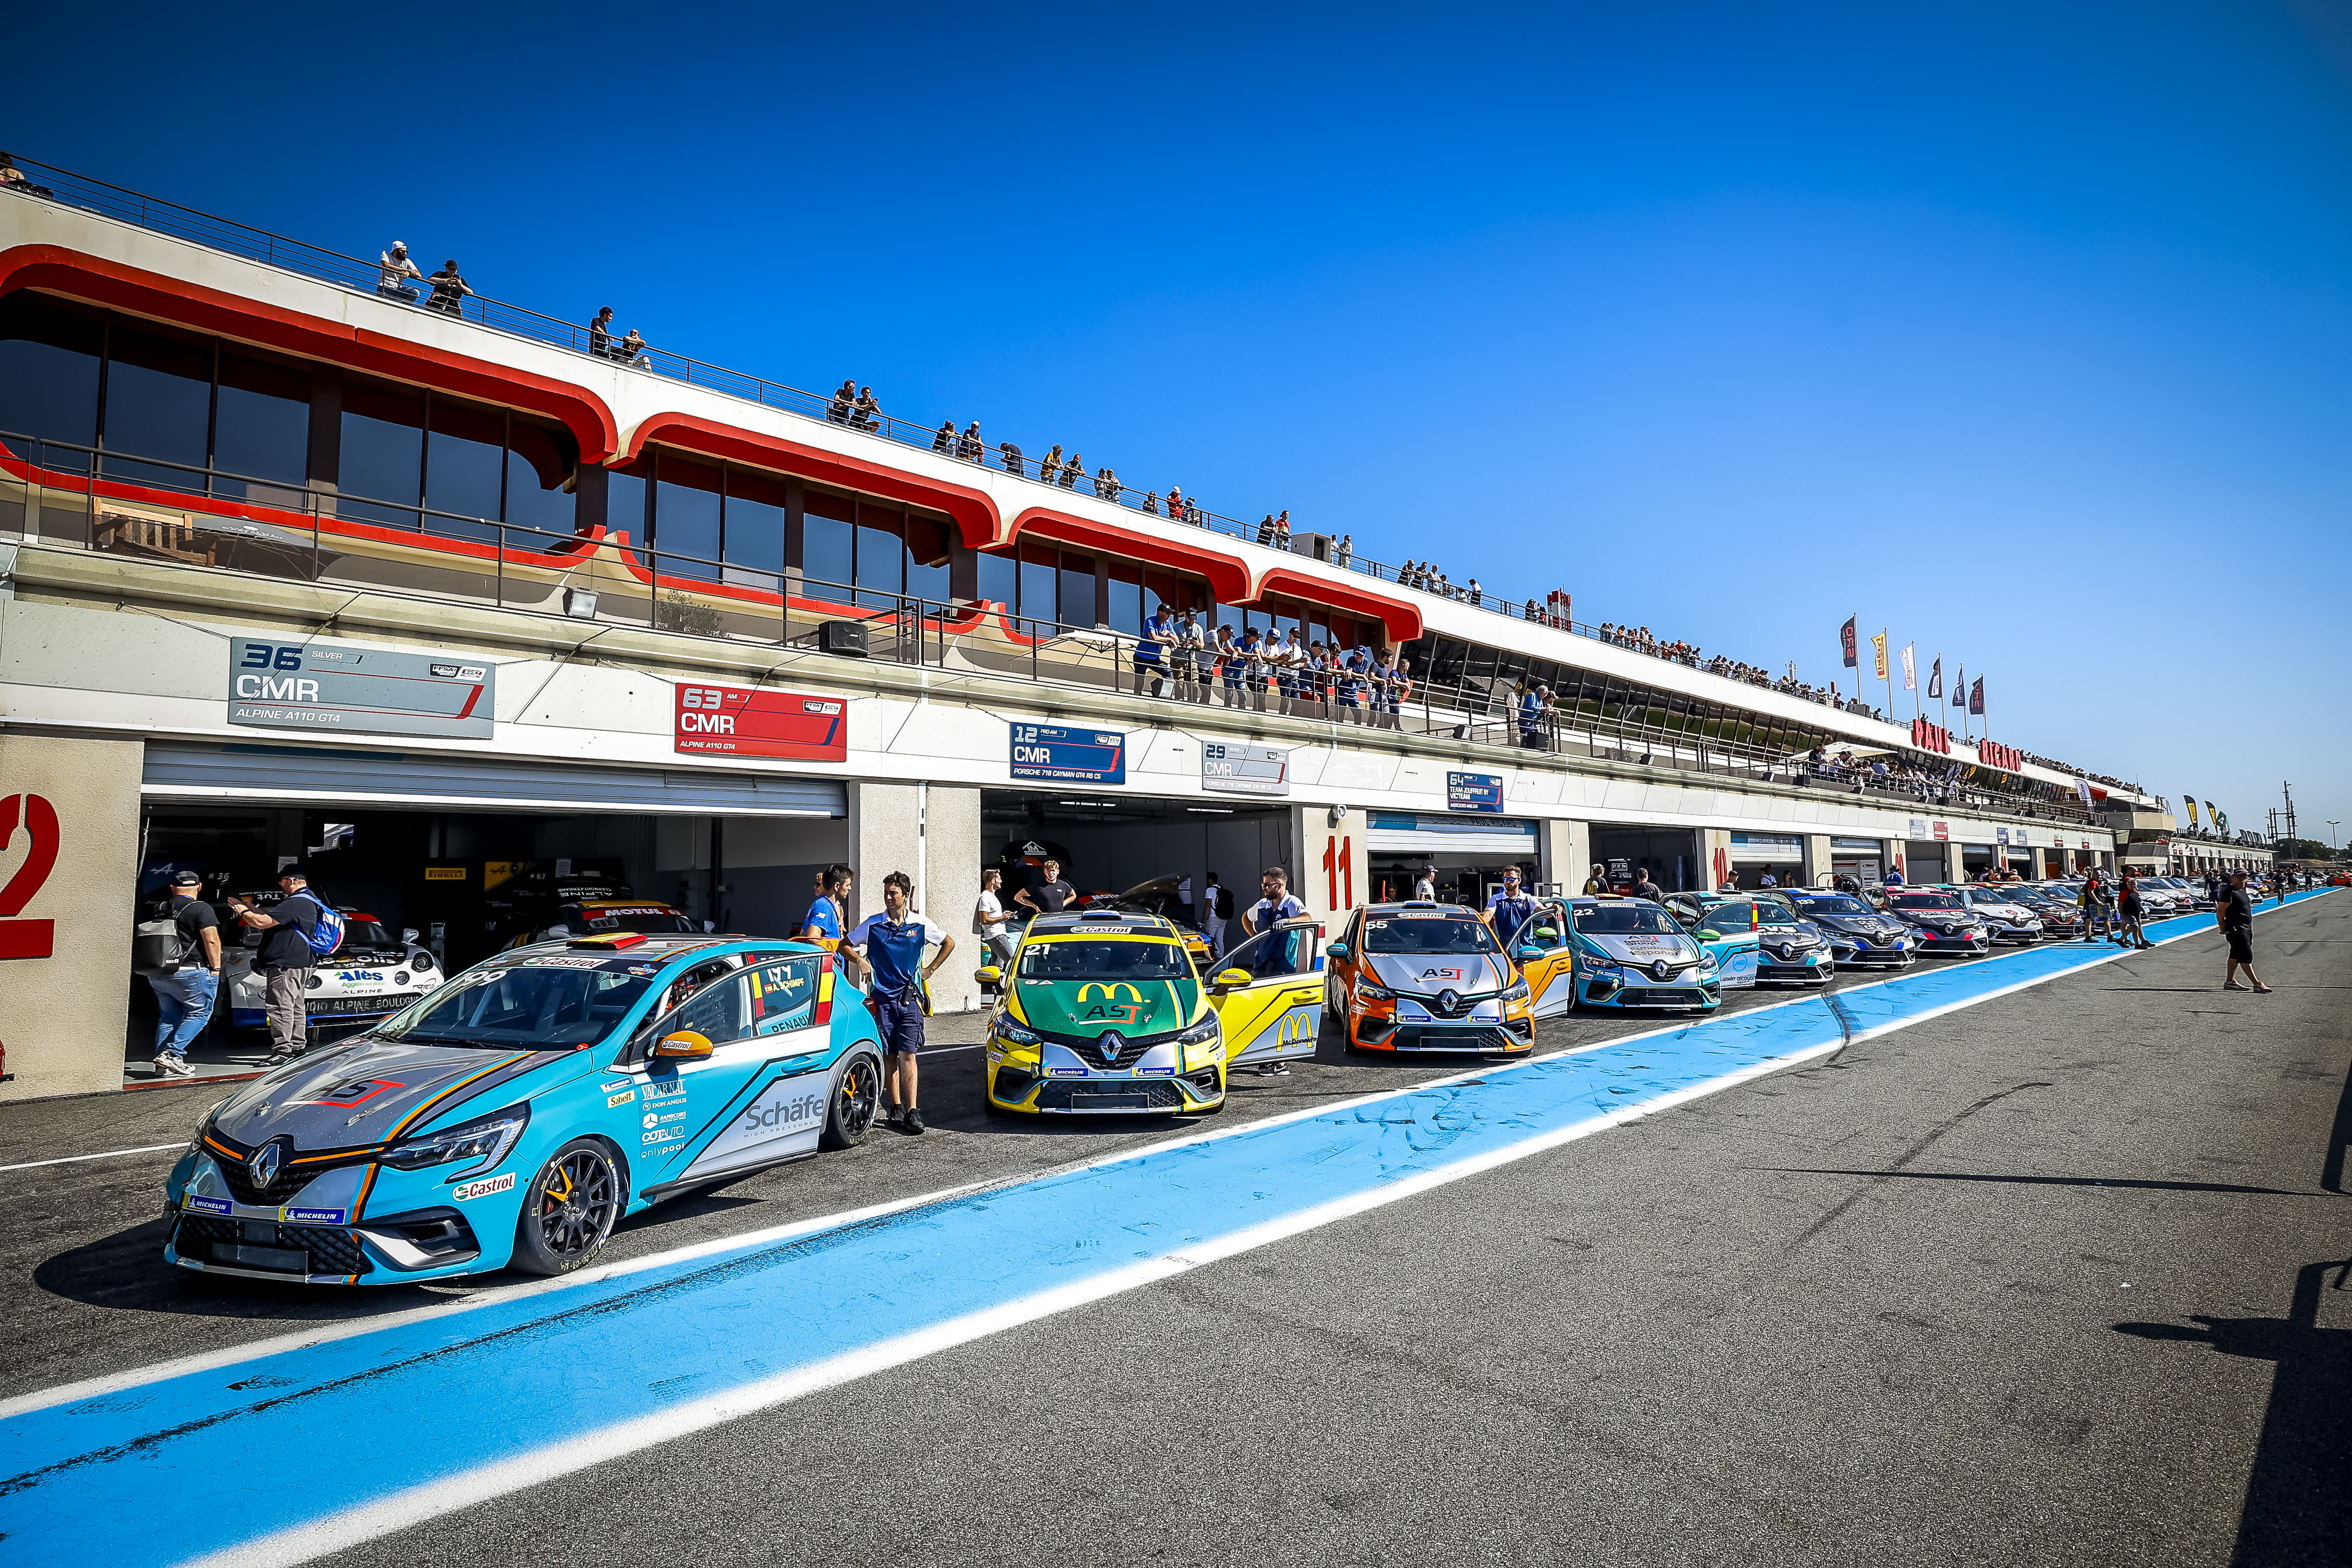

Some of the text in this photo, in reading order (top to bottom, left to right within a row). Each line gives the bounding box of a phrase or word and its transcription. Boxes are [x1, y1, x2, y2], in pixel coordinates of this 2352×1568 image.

[240, 643, 343, 672] 36 SILVER
[236, 674, 319, 702] CMR
[682, 688, 723, 710] 63
[236, 708, 341, 723] ALPINE A110 GT4
[681, 712, 735, 734] CMR
[1014, 725, 1037, 743] 12
[1206, 744, 1226, 759] 29
[1913, 719, 2021, 772] PAUL RICARD
[1014, 746, 1050, 764] CMR
[1205, 762, 1232, 776] CMR
[1450, 774, 1464, 786] 64
[428, 869, 464, 879] PIRELLI
[1323, 836, 1352, 911] 11
[1365, 920, 1388, 929] 55
[1025, 944, 1051, 956] 21
[541, 957, 604, 969] Castrol
[339, 970, 383, 981] Alès
[1422, 968, 1465, 981] AST
[667, 1041, 690, 1049] Castrol
[1282, 1036, 1317, 1046] McDonald's
[989, 1052, 1002, 1063] Castrol
[641, 1080, 687, 1099] VACARNAL
[611, 1092, 631, 1106] Sabelt
[666, 1098, 687, 1106] ANGUS
[660, 1111, 687, 1121] RAPRICONS
[770, 1121, 813, 1133] PRESSURE
[641, 1142, 685, 1158] onlypool
[470, 1176, 513, 1197] Castrol
[197, 1201, 227, 1210] MICHELIN
[296, 1212, 337, 1220] MICHELIN
